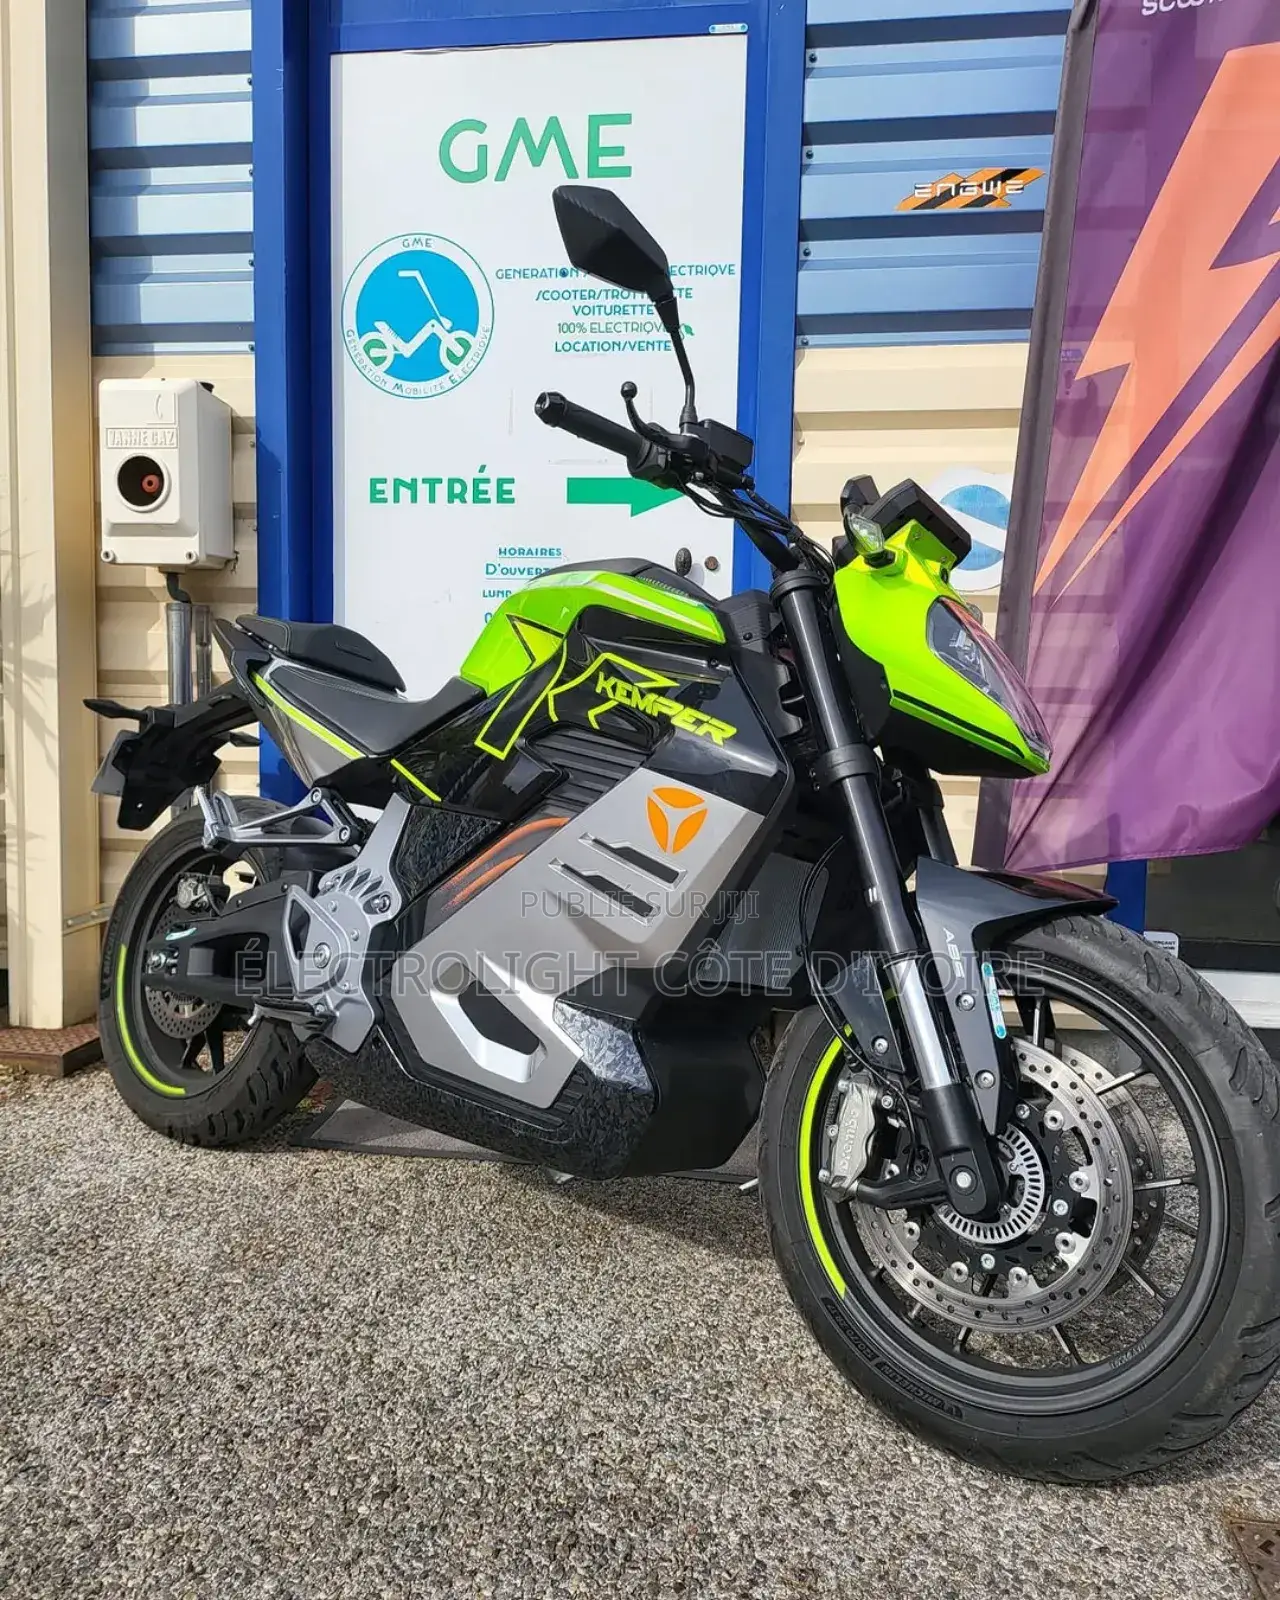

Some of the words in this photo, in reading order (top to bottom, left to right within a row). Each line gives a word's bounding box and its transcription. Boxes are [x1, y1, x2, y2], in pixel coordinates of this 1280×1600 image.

[439, 113, 632, 183] GME
[402, 237, 432, 248] GME
[495, 267, 580, 280] GENERATION
[572, 304, 654, 316] VOITURETTE
[558, 322, 588, 334] 100%
[555, 340, 672, 353] LOCATION/VENTE
[151, 430, 175, 446] GAZ
[369, 464, 516, 505] ENTRÉE
[498, 547, 562, 557] HORAIRES
[595, 671, 738, 747] KEMPER
